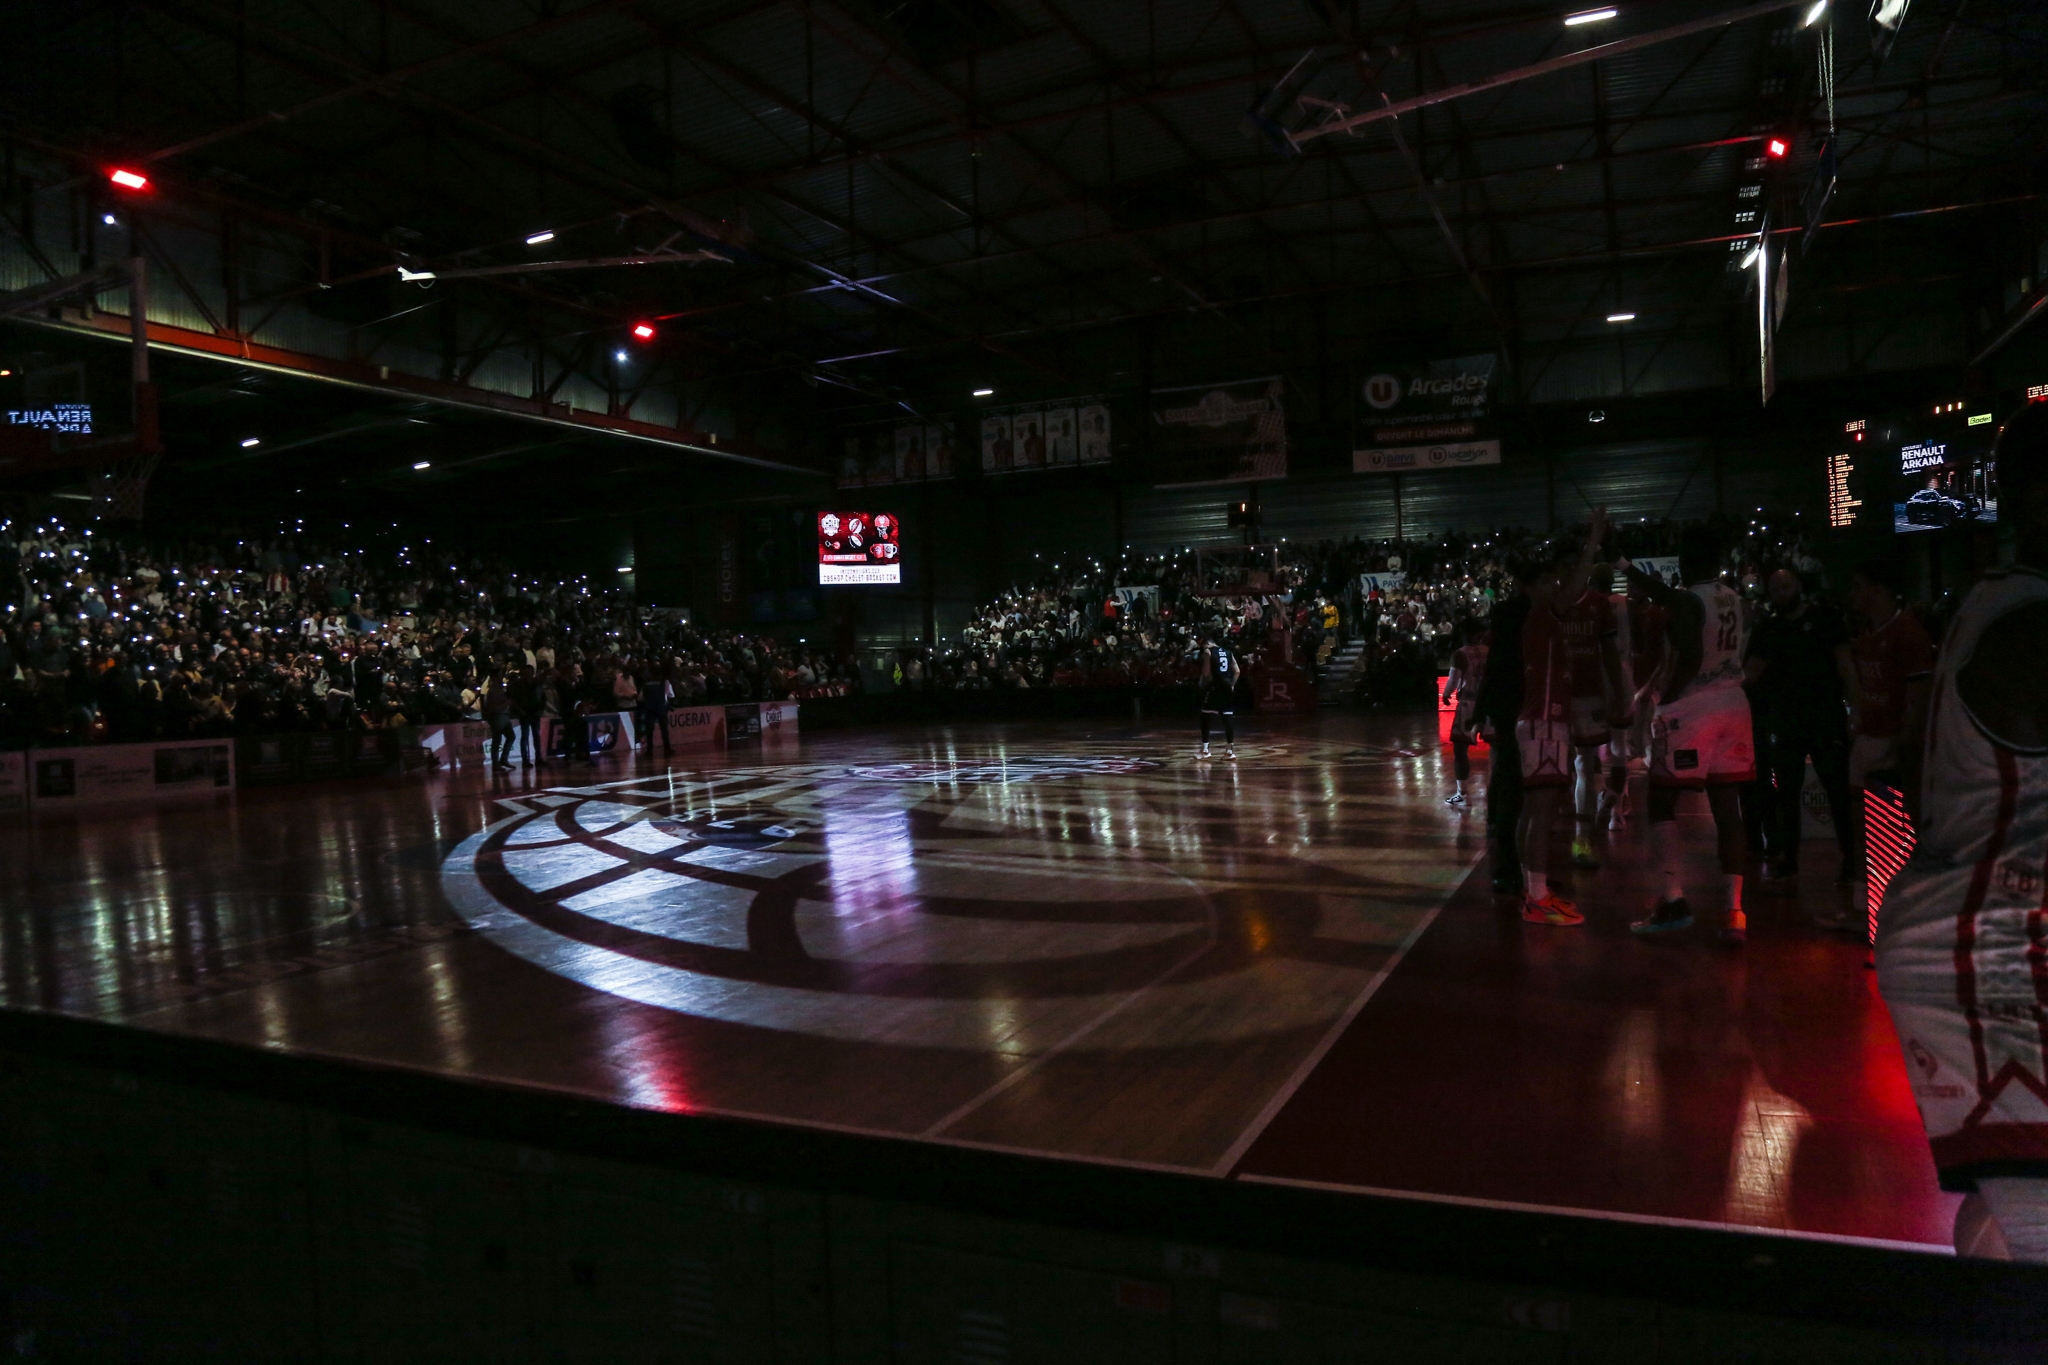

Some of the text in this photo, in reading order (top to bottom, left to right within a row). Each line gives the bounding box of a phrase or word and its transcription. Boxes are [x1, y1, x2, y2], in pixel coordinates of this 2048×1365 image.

[1371, 382, 1392, 402] U
[1408, 372, 1490, 396] Arcades
[1166, 408, 1207, 421] SAVEURS
[1377, 425, 1475, 442] OUVERT LE DIMANCHE
[1386, 453, 1416, 463] DRIVE
[1448, 448, 1488, 459] location
[1902, 444, 1946, 460] RENAULT
[1902, 455, 1944, 470] ARKANA
[1717, 610, 1737, 651] 12
[1219, 656, 1228, 672] 3
[765, 710, 782, 723] CHOLET
